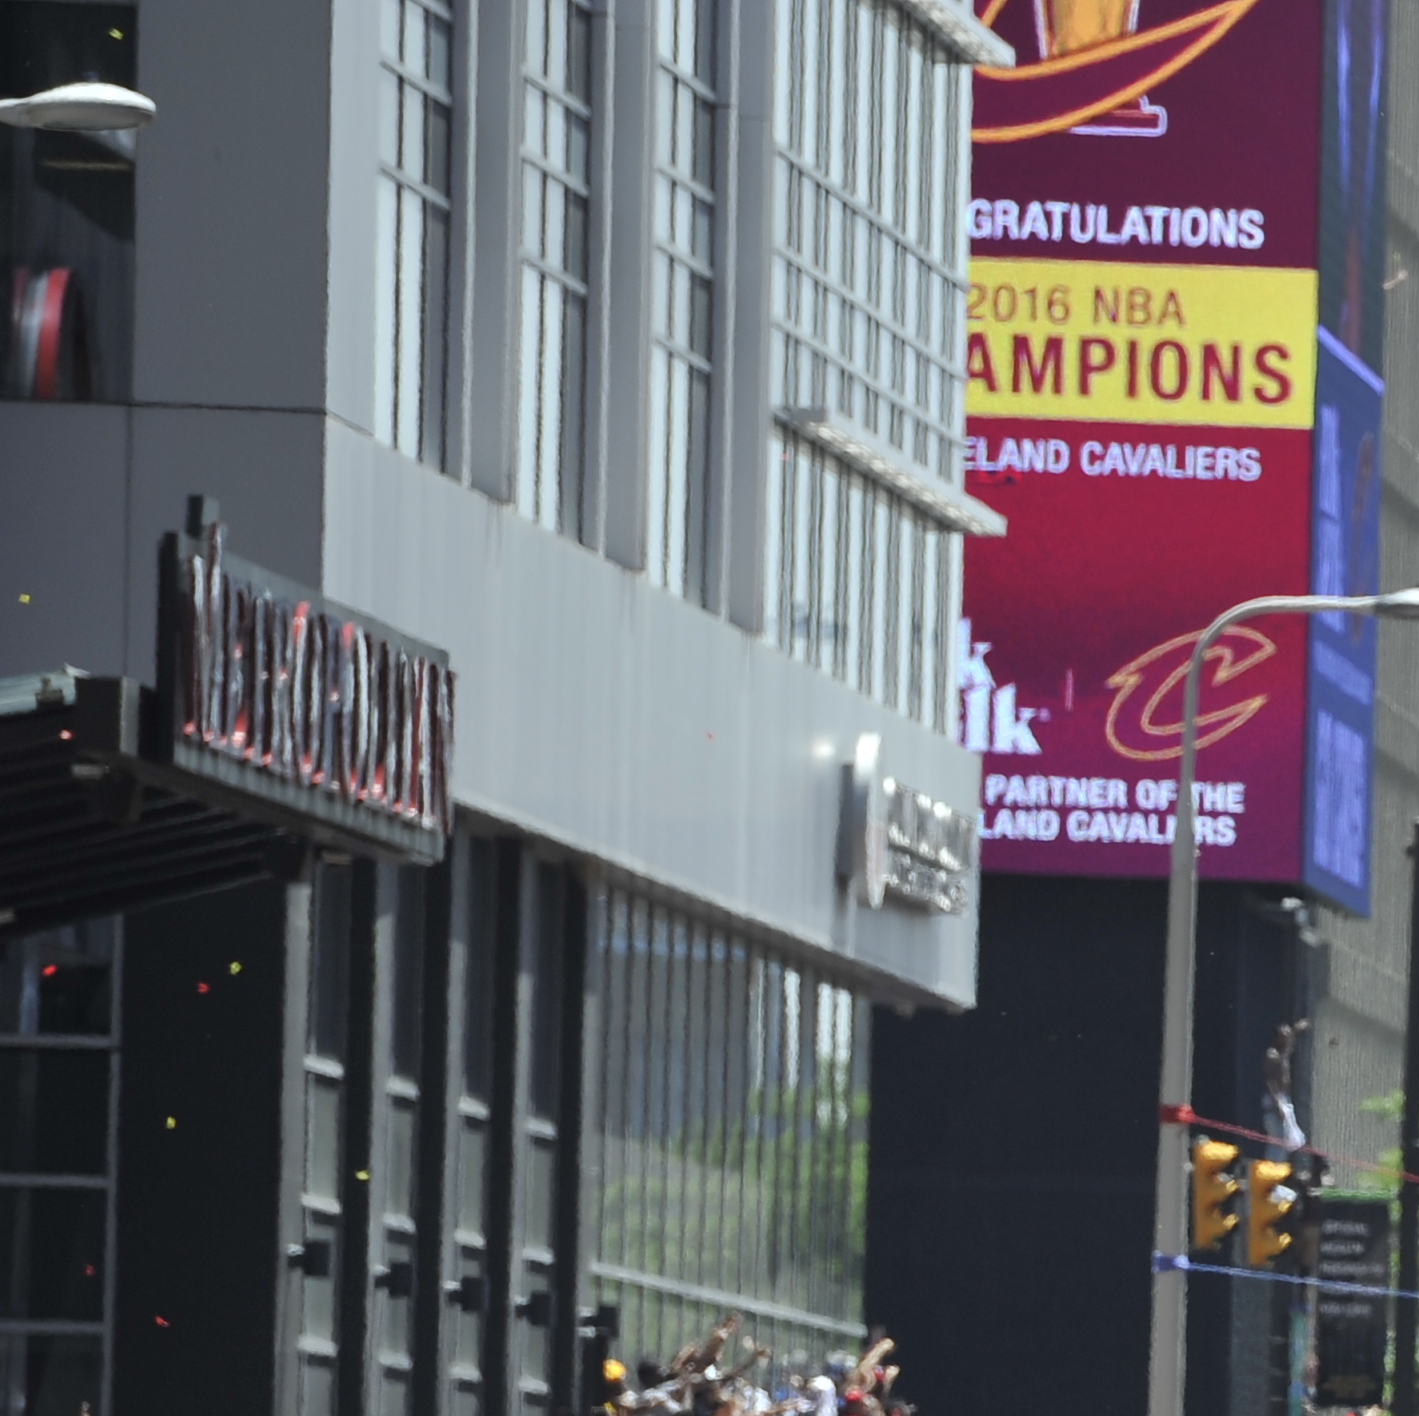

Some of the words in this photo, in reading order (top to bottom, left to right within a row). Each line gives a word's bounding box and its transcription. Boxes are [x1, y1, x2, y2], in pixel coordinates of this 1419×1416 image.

[968, 199, 1265, 250] GRATULATIONS
[965, 283, 1070, 325] 2016
[1093, 285, 1185, 328] NBA
[967, 332, 1292, 405] AMPIONS
[1080, 442, 1262, 483] CAVALIERS
[985, 773, 1128, 810] PARTNER
[1135, 779, 1179, 811] OF
[1191, 781, 1246, 814] THE
[977, 807, 1061, 842] LAND
[1066, 810, 1237, 847] CAVALIRS
